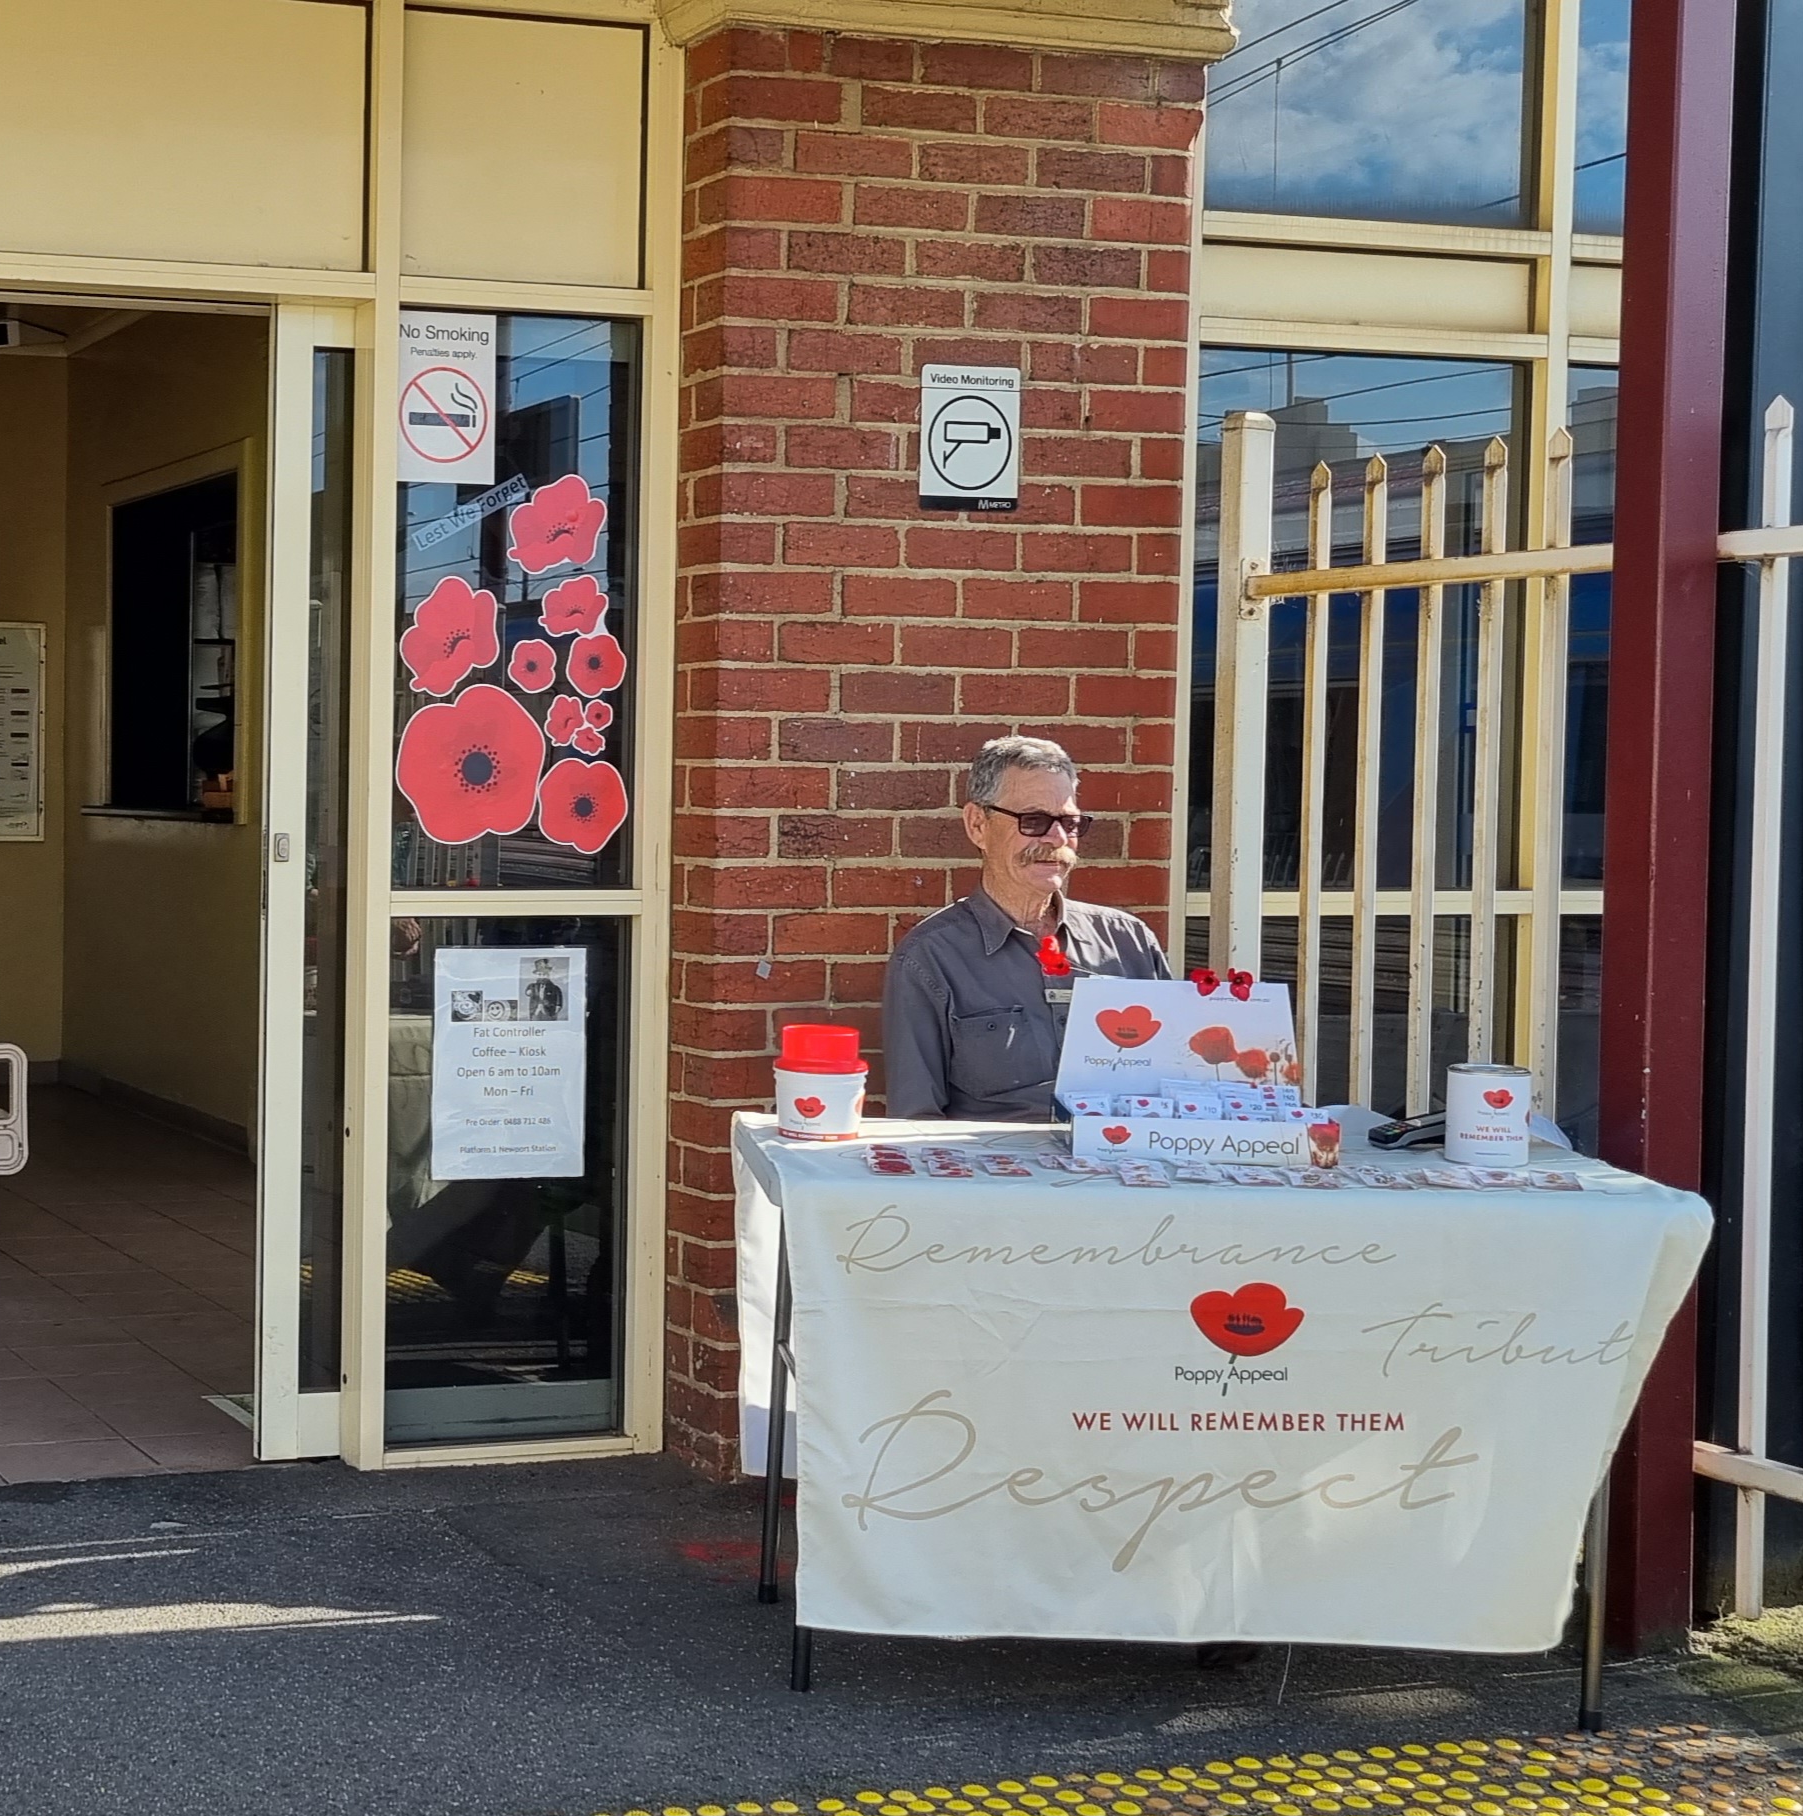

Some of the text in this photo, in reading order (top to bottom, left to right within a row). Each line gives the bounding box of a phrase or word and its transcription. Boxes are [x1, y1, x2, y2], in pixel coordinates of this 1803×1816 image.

[399, 323, 490, 346] No Smoking
[410, 347, 478, 360] Penalties apply.
[930, 373, 1015, 388] Video Monitoring
[414, 476, 527, 550] Lest We Forget
[473, 1026, 547, 1038] Fat Controller
[472, 1047, 507, 1058] Coffee
[519, 1046, 547, 1057] Kiosk
[1084, 1055, 1152, 1068] Poppy Appeal
[457, 1066, 561, 1079] Open 6 am to 10am
[483, 1087, 508, 1097] Mon
[520, 1085, 534, 1097] Fri
[1149, 1130, 1299, 1158] Poppy Appeal
[835, 1204, 1400, 1276] Remembrance
[1174, 1365, 1288, 1383] Poppy Appeal
[1072, 1410, 1405, 1432] WE WILL REMEMBER THEM
[841, 1388, 1479, 1572] Respect
